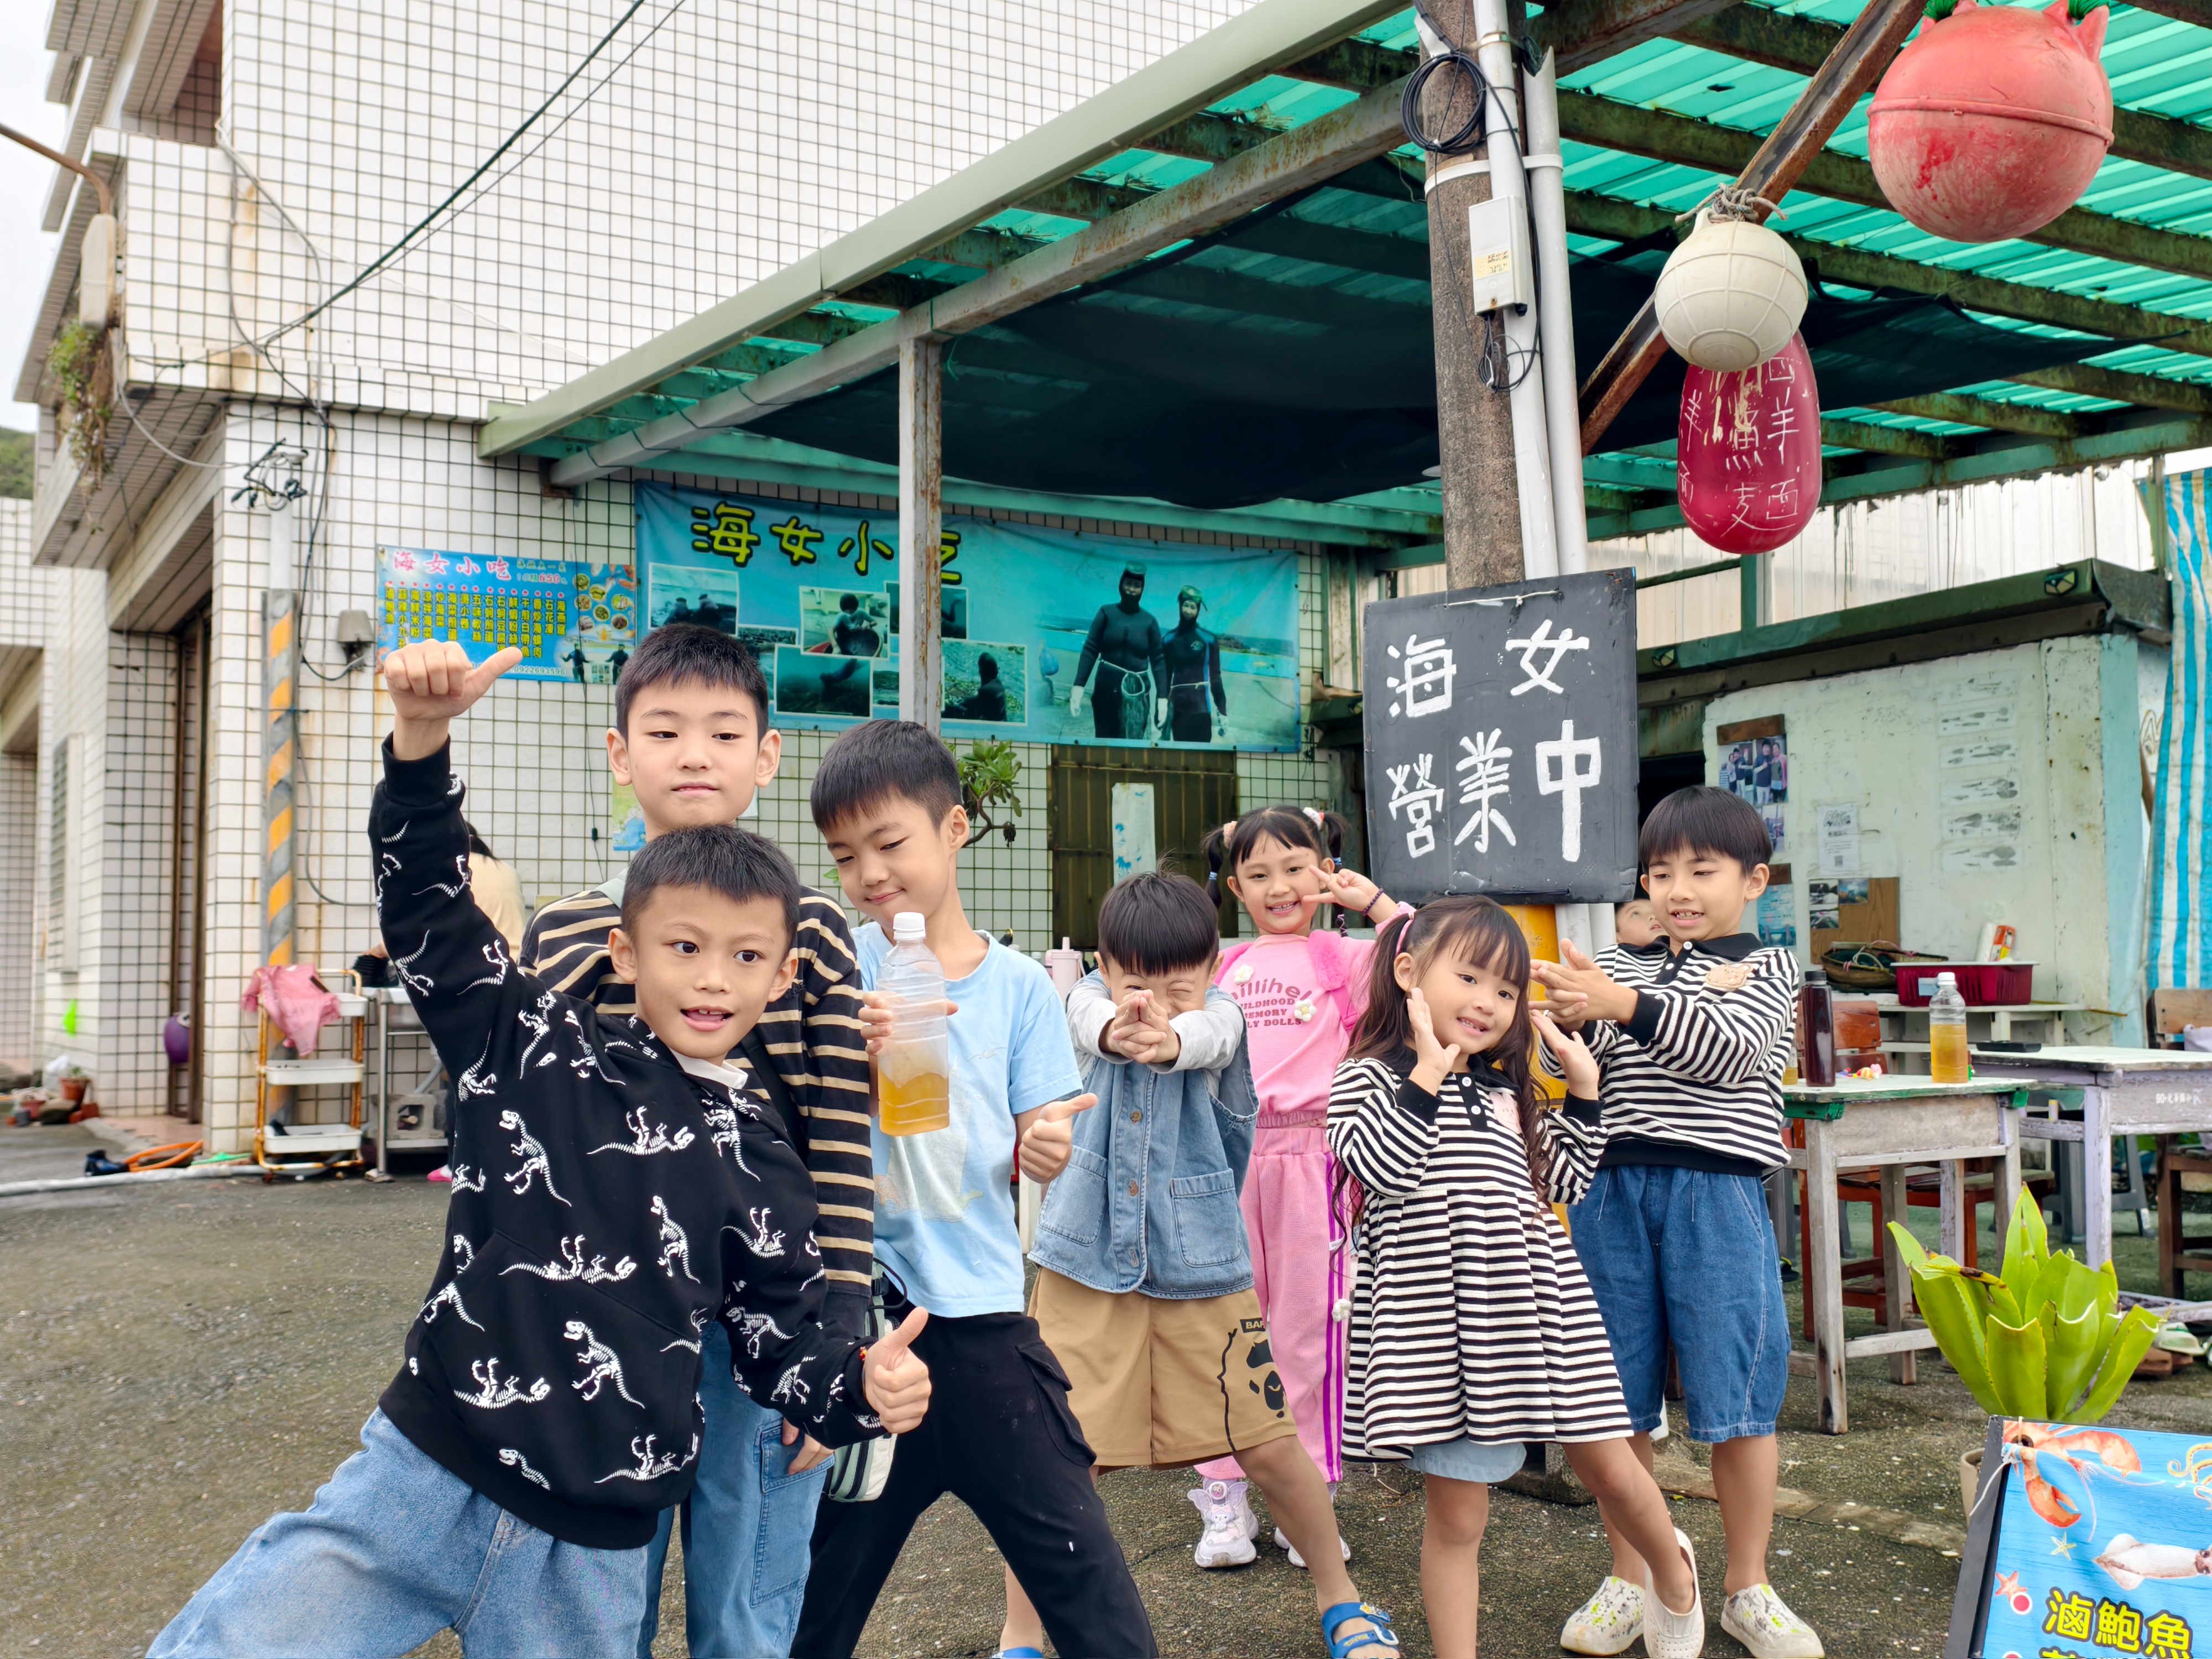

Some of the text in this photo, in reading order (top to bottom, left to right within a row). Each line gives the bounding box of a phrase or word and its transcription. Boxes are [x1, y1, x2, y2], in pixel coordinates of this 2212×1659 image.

[393, 550, 512, 581] 海女小吃
[1386, 619, 1590, 717] 海女
[1386, 719, 1601, 863] 營業中
[1264, 1018, 1302, 1026] DOLLS
[2044, 1589, 2192, 1659] 滷鮑魚
